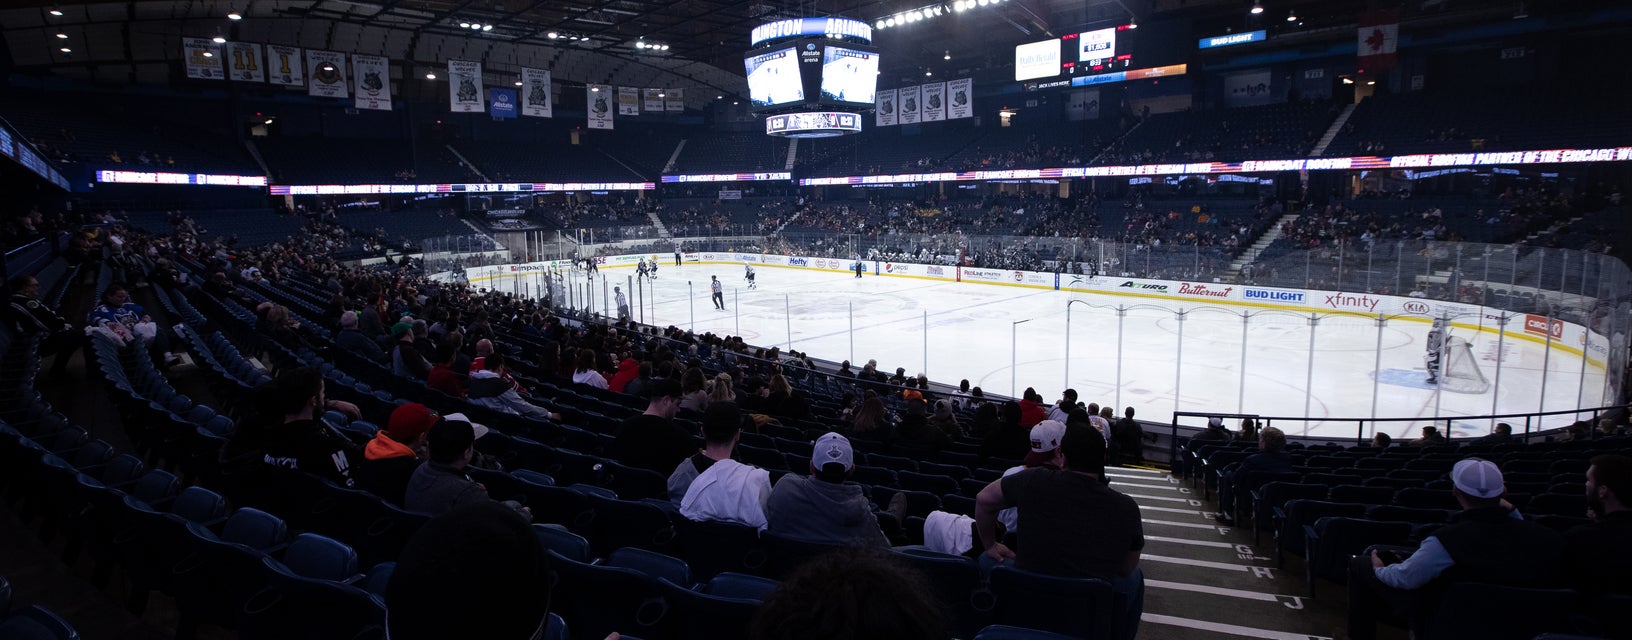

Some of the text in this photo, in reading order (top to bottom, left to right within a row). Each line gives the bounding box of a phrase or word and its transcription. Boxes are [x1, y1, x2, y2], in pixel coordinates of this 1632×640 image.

[1211, 33, 1252, 46] BUD LIGHT
[233, 50, 258, 70] 11
[279, 54, 292, 74] 1
[1390, 155, 1429, 168] OFFICIAL
[1430, 154, 1474, 166] ROOFING
[1475, 152, 1522, 165] PARTNER
[1523, 151, 1539, 163] OF
[1538, 150, 1560, 163] THE
[1561, 149, 1614, 162] CHICAGO
[789, 256, 807, 267] Hefty
[893, 264, 908, 272] pepsi
[1178, 282, 1233, 298] Butternut
[1245, 289, 1304, 301] BUD LIGHT
[1324, 292, 1379, 312] xfinity
[1407, 303, 1426, 312] KIA
[1188, 498, 1202, 507] D
[1217, 527, 1231, 536] F
[1234, 543, 1254, 555] G
[1251, 567, 1275, 580] H
[1283, 596, 1304, 610] J
